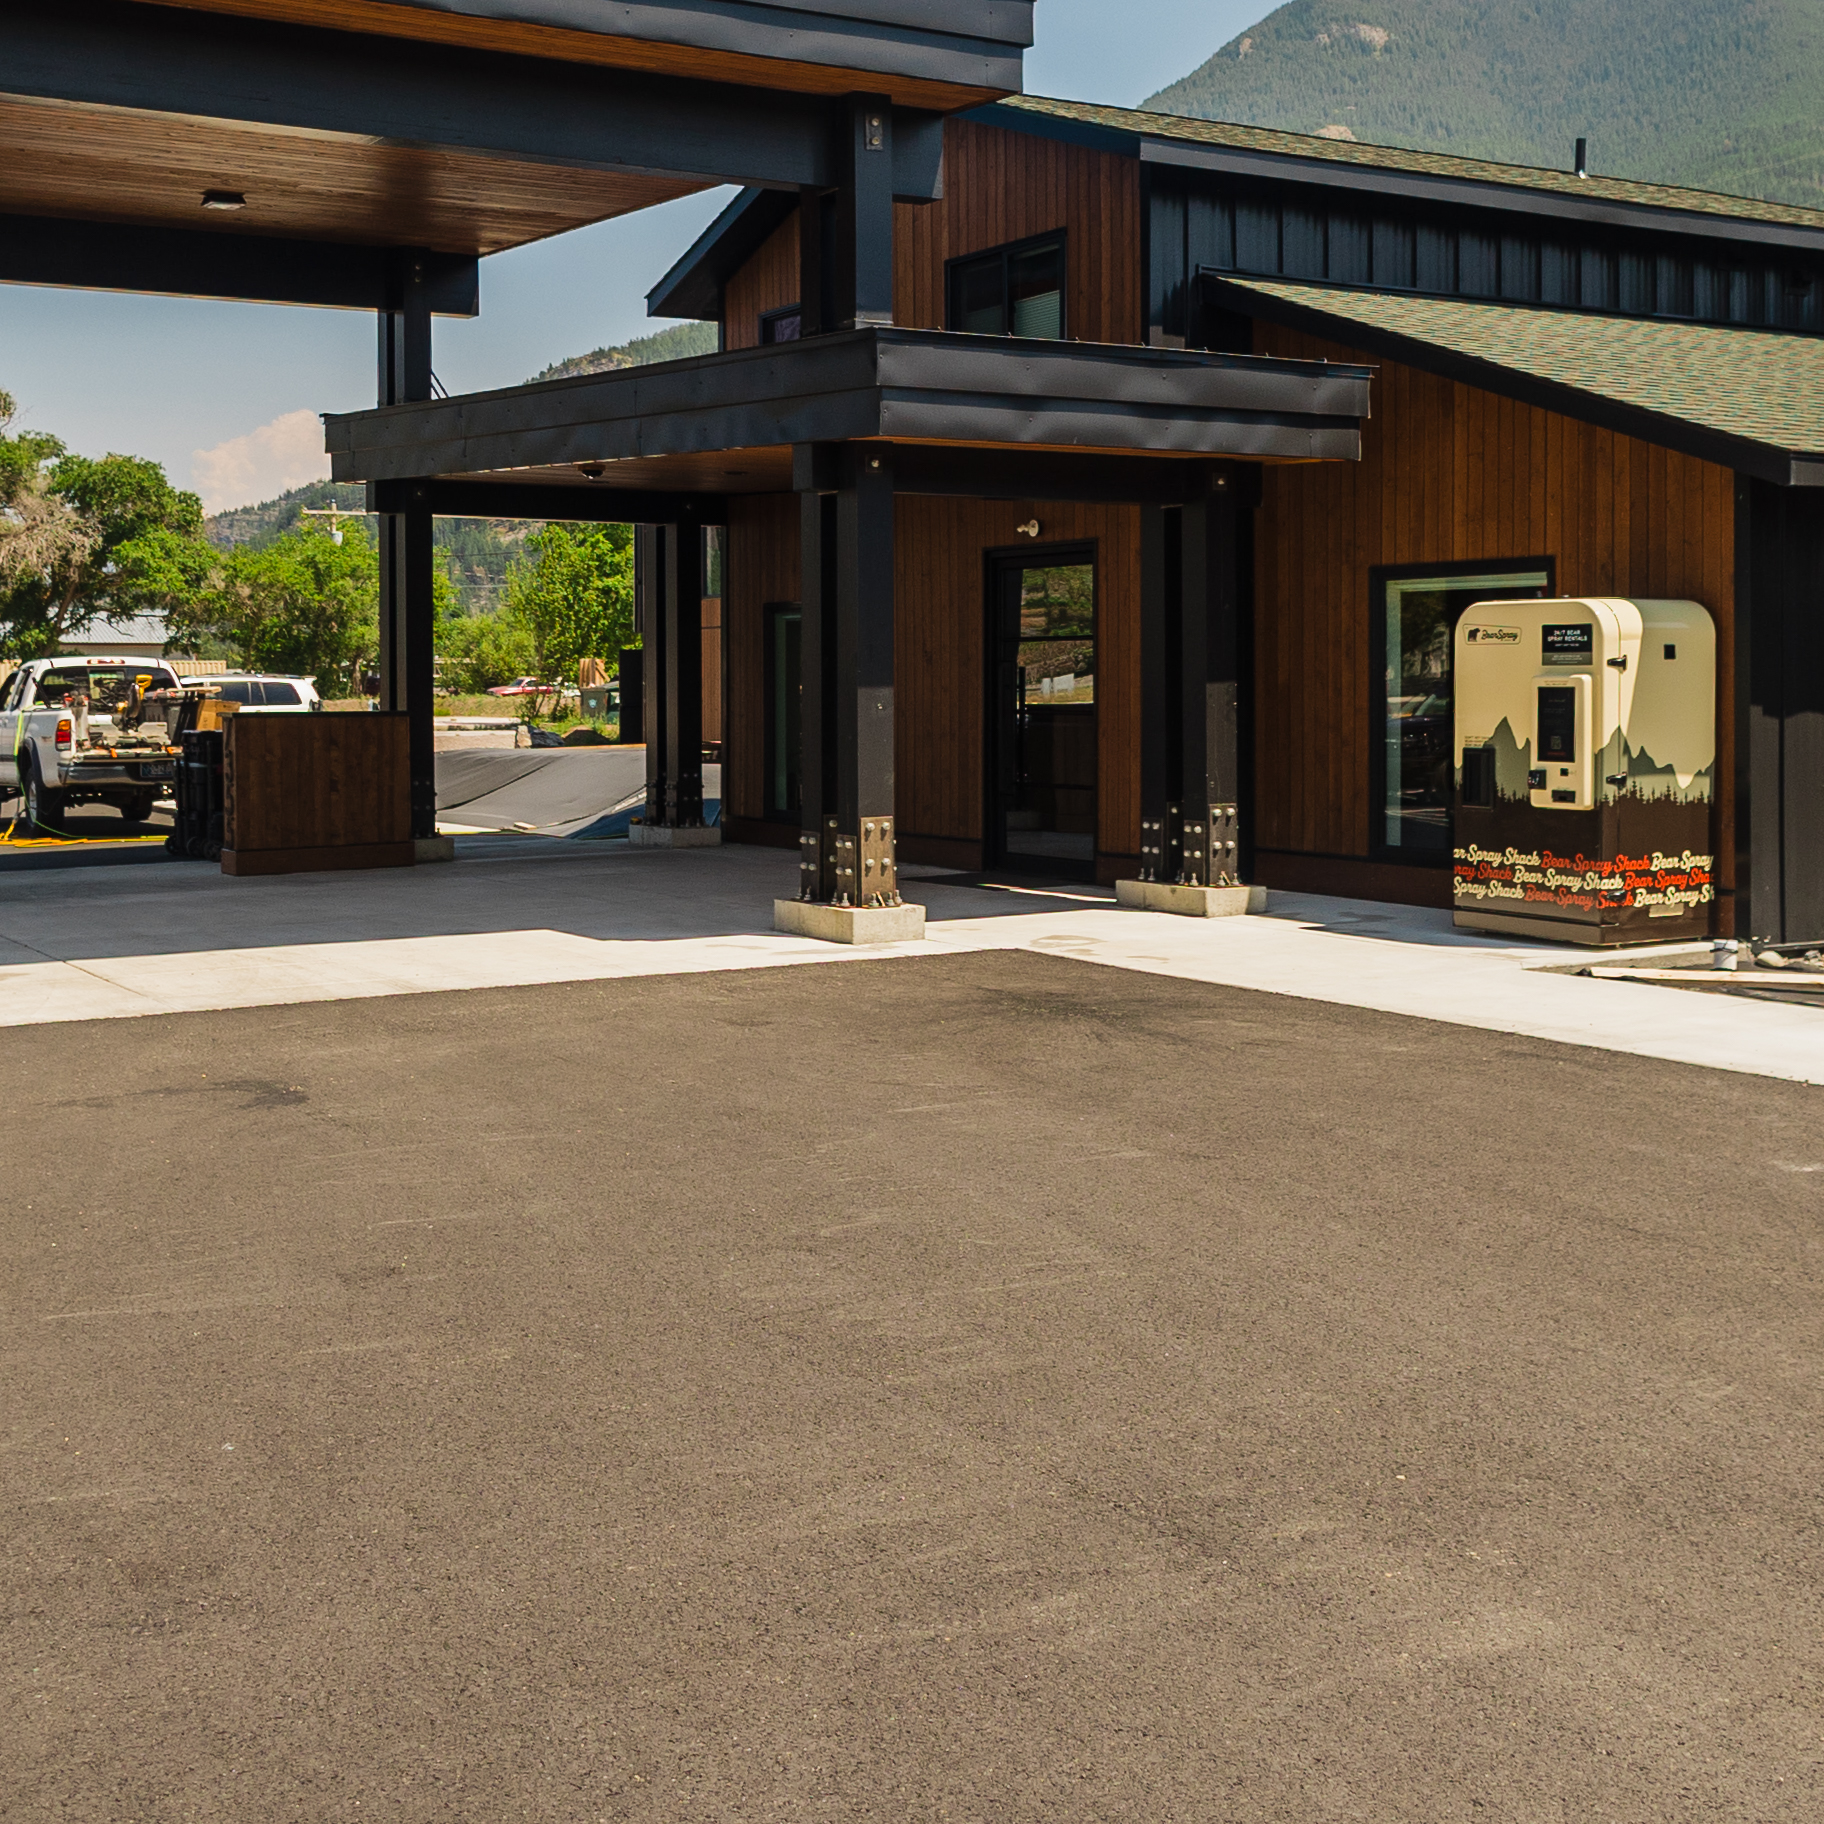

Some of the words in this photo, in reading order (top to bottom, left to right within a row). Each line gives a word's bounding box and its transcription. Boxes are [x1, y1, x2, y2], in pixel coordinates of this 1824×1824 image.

[1466, 844, 1502, 867] Spray
[1503, 847, 1541, 865] Shack
[1541, 851, 1572, 868] Bear
[1572, 853, 1612, 877] Spray
[1613, 854, 1650, 873] Shack
[1649, 851, 1680, 871] Bear
[1680, 850, 1714, 872] Spray
[1477, 862, 1513, 880] Shack
[1513, 865, 1544, 883] Bear
[1544, 868, 1583, 892] Spray
[1583, 871, 1624, 890] Shack
[1623, 871, 1653, 890] Bear
[1654, 869, 1688, 891] Spray
[1453, 876, 1488, 900] Spray
[1488, 880, 1525, 898] Shack
[1524, 884, 1556, 901] Bear
[1556, 887, 1596, 912] Spray
[1633, 888, 1665, 908] Bear
[1664, 886, 1700, 908] Spray
